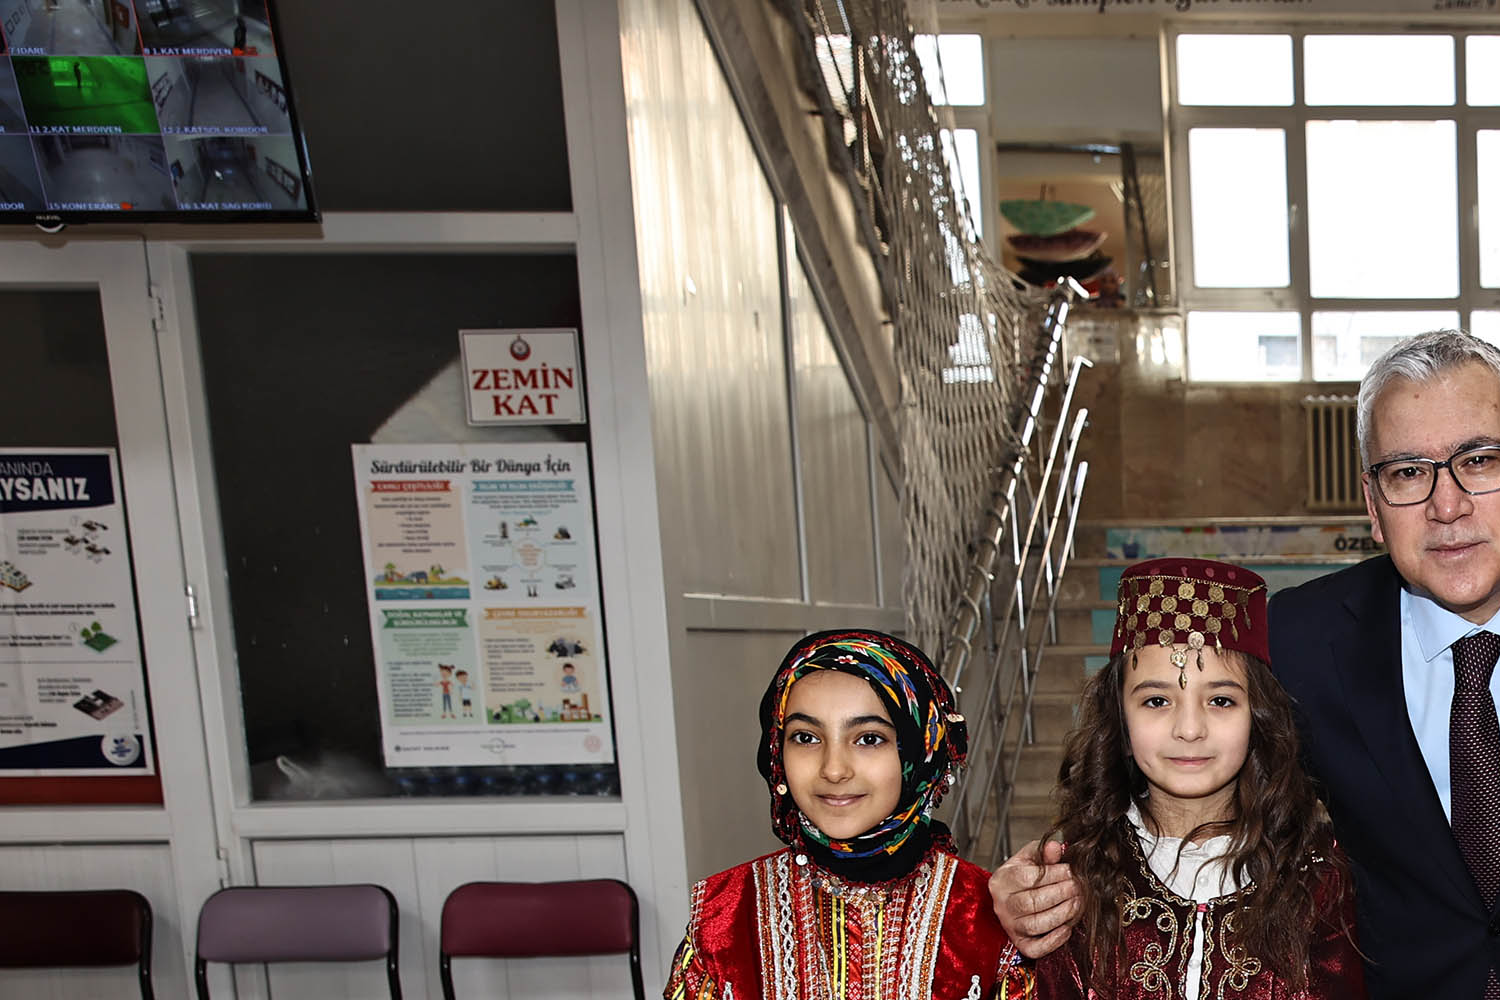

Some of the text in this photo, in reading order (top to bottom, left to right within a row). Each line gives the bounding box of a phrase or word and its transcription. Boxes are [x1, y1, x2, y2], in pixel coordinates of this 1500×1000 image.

[472, 362, 574, 391] ZEMİN
[492, 394, 559, 416] KAT
[371, 453, 571, 476] Sürdürülebilir Bir Dünya İçin
[0, 477, 90, 501] YSANIZ
